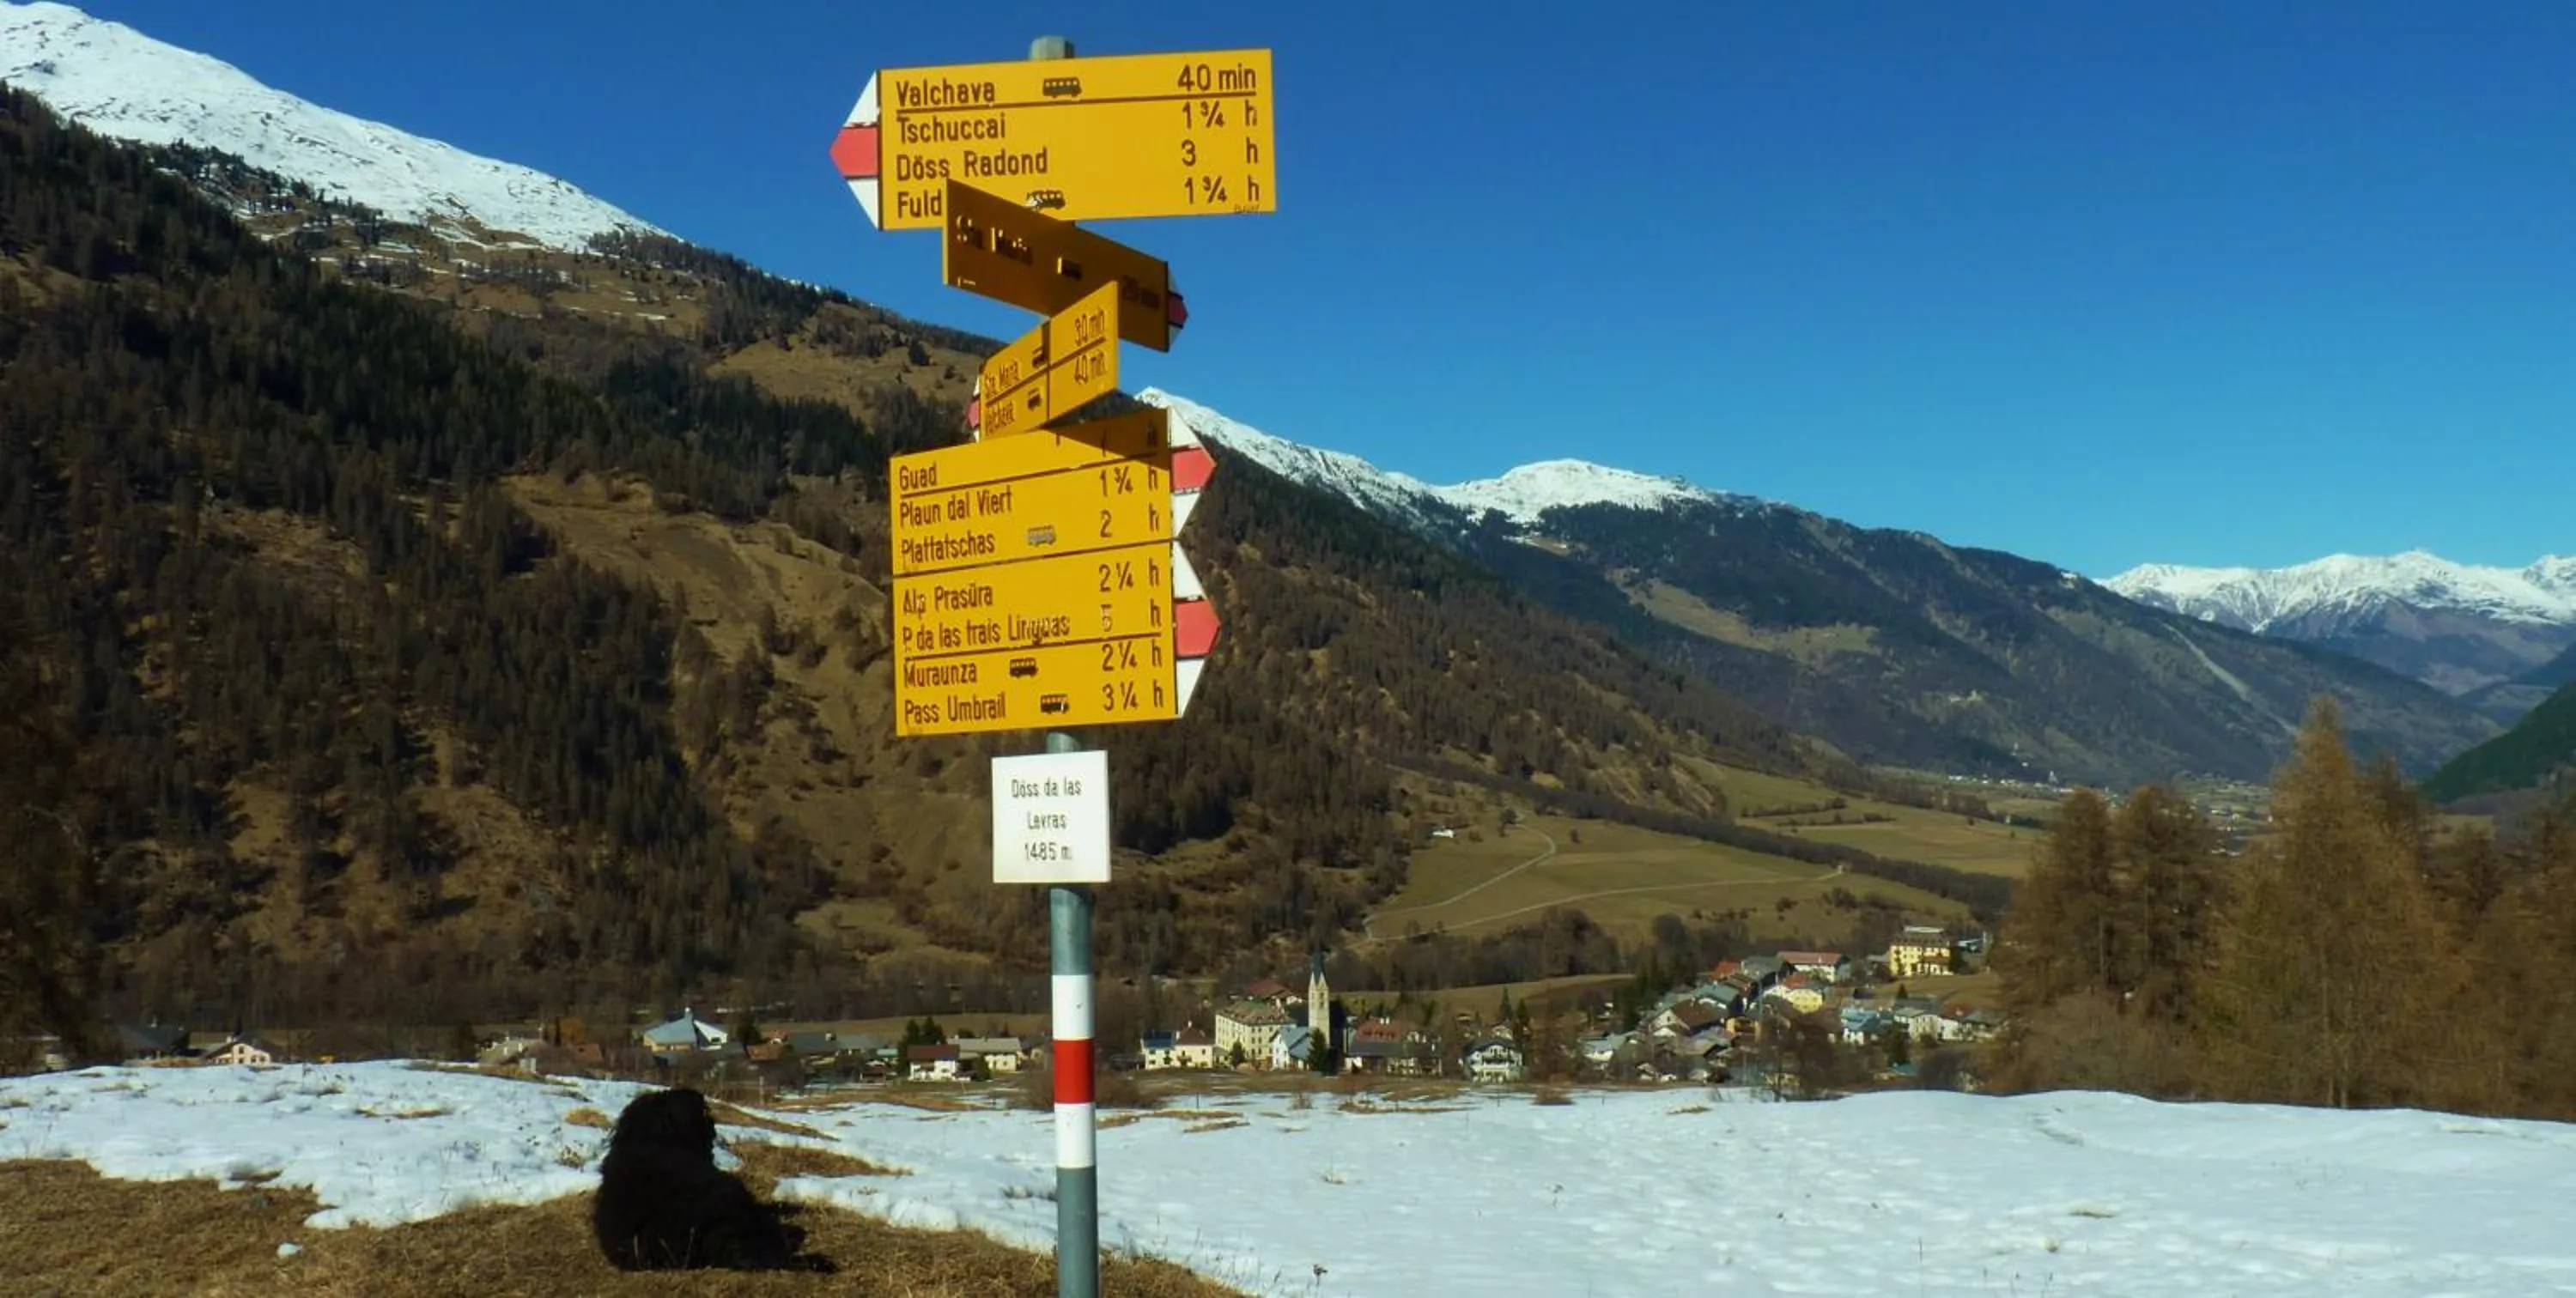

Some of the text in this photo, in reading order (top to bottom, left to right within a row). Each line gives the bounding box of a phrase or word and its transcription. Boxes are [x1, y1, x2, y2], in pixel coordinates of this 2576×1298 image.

[896, 64, 1256, 106] Valchava 40 min
[897, 115, 1005, 143] Tschuccai
[1246, 100, 1257, 127] h
[897, 137, 1258, 181] Döss Radond 3 h
[897, 189, 942, 219] Fuld
[1249, 176, 1259, 201] h
[1074, 353, 1088, 384] 40
[899, 463, 937, 491] Guad
[900, 500, 941, 529] Plaun
[947, 494, 970, 520] dal
[977, 484, 1012, 517] Viert
[1148, 464, 1158, 490] h
[901, 503, 1159, 567] Plattatschas 2 h
[902, 587, 926, 620] Alp
[934, 583, 993, 611] Prasüra
[1149, 558, 1159, 586] h
[916, 624, 933, 650] da
[939, 622, 961, 647] las
[967, 618, 1001, 646] trais
[1150, 597, 1162, 628] h
[904, 660, 977, 688] Muraunza
[1151, 640, 1162, 667] h
[904, 700, 939, 725] Pass
[948, 692, 1005, 722] Umbrail
[1153, 679, 1163, 708] h
[1012, 776, 1082, 798] Döss da las
[1024, 841, 1057, 861] 1485
